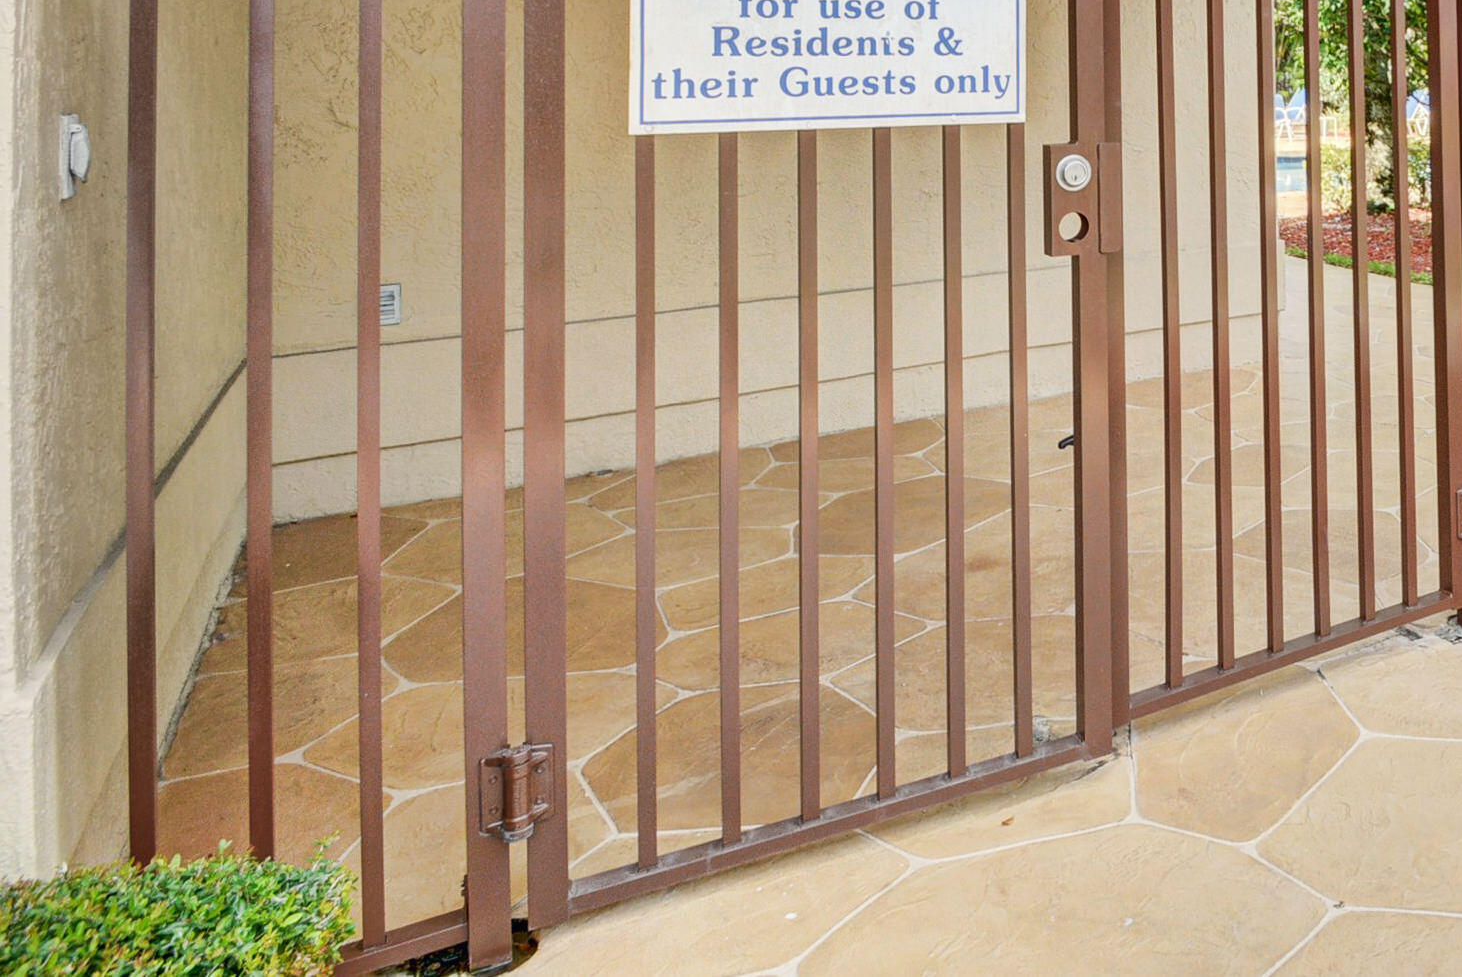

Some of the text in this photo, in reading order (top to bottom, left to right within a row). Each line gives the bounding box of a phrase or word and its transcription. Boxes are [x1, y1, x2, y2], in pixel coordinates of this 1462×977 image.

[711, 26, 965, 58] Residents &
[651, 65, 1011, 100] their Guests only
